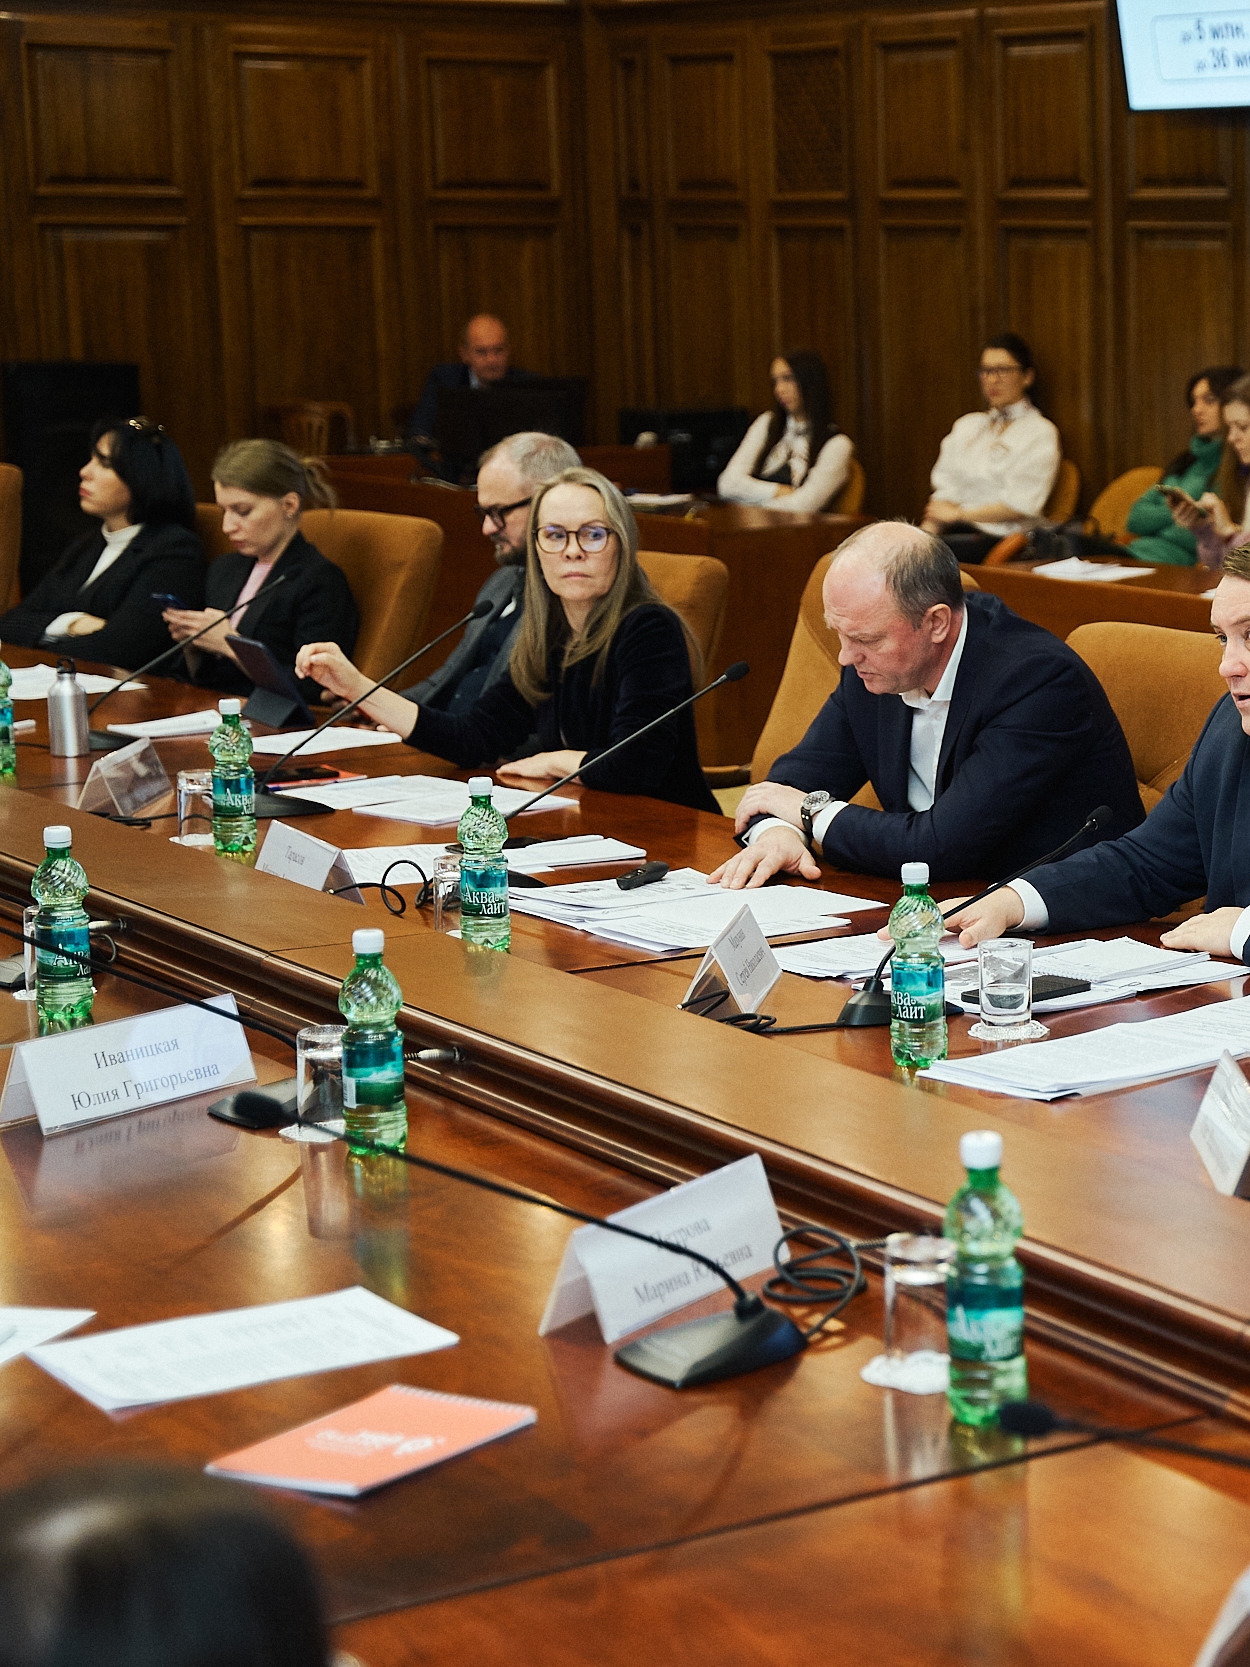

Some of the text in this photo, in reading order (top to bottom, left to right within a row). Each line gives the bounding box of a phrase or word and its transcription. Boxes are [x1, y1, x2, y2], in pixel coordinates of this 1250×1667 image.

[1210, 48, 1228, 69] 36
[462, 883, 496, 905] Аква
[479, 896, 506, 915] лайт
[896, 998, 926, 1019] лайт
[94, 1038, 180, 1070] Иваницкая
[71, 1063, 221, 1112] Юлия Григорьевна
[652, 1218, 711, 1250] етрова
[634, 1244, 753, 1306] Марина Юьевна
